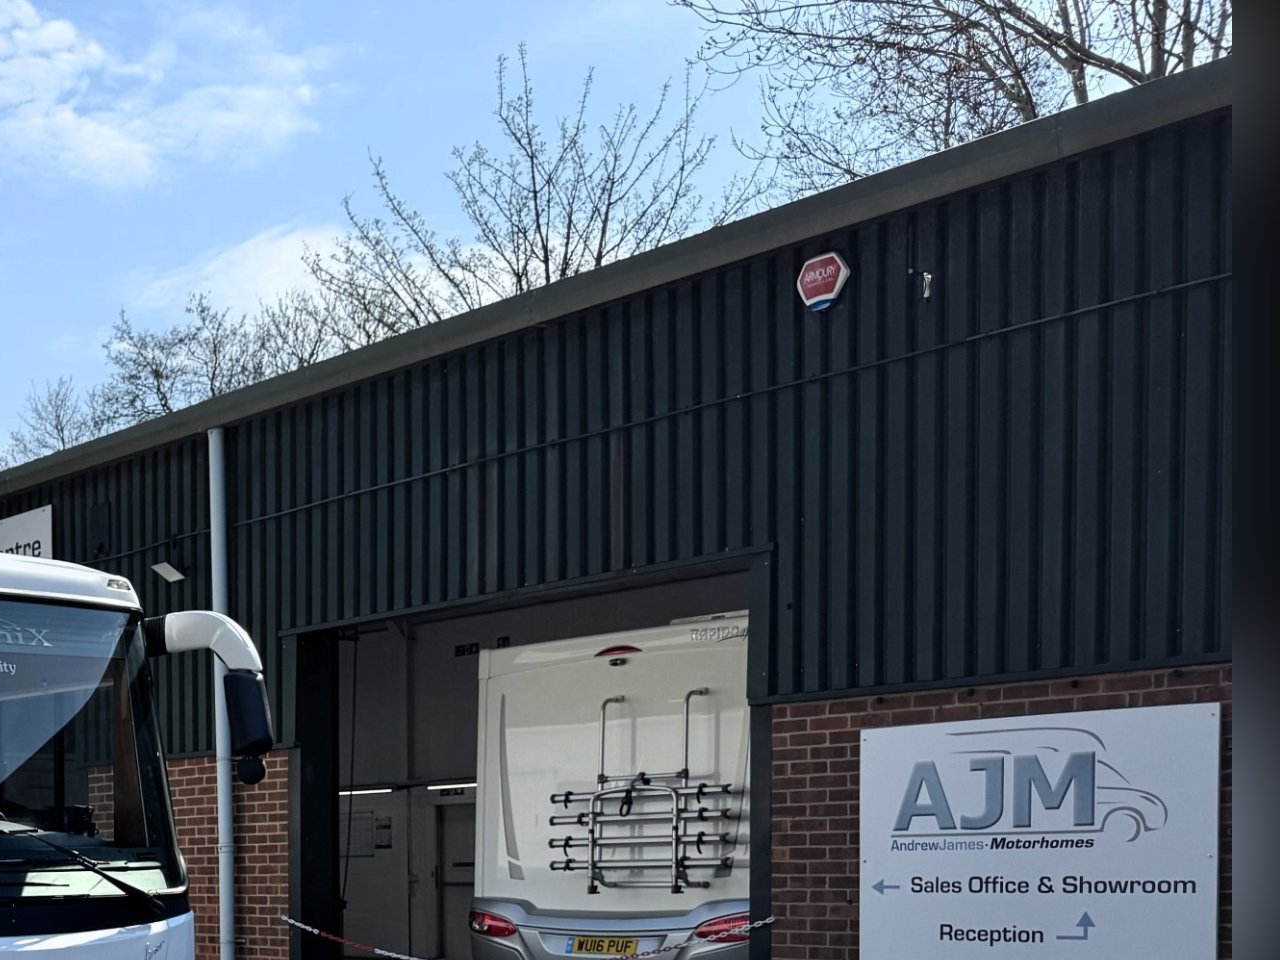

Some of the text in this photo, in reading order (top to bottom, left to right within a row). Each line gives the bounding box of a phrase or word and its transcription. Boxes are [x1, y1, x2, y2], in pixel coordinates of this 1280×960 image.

[892, 750, 1096, 832] AJM
[910, 875, 1197, 895] Sales Office & Showroom
[577, 938, 633, 954] WU16 PUF
[939, 924, 1044, 947] Reception
